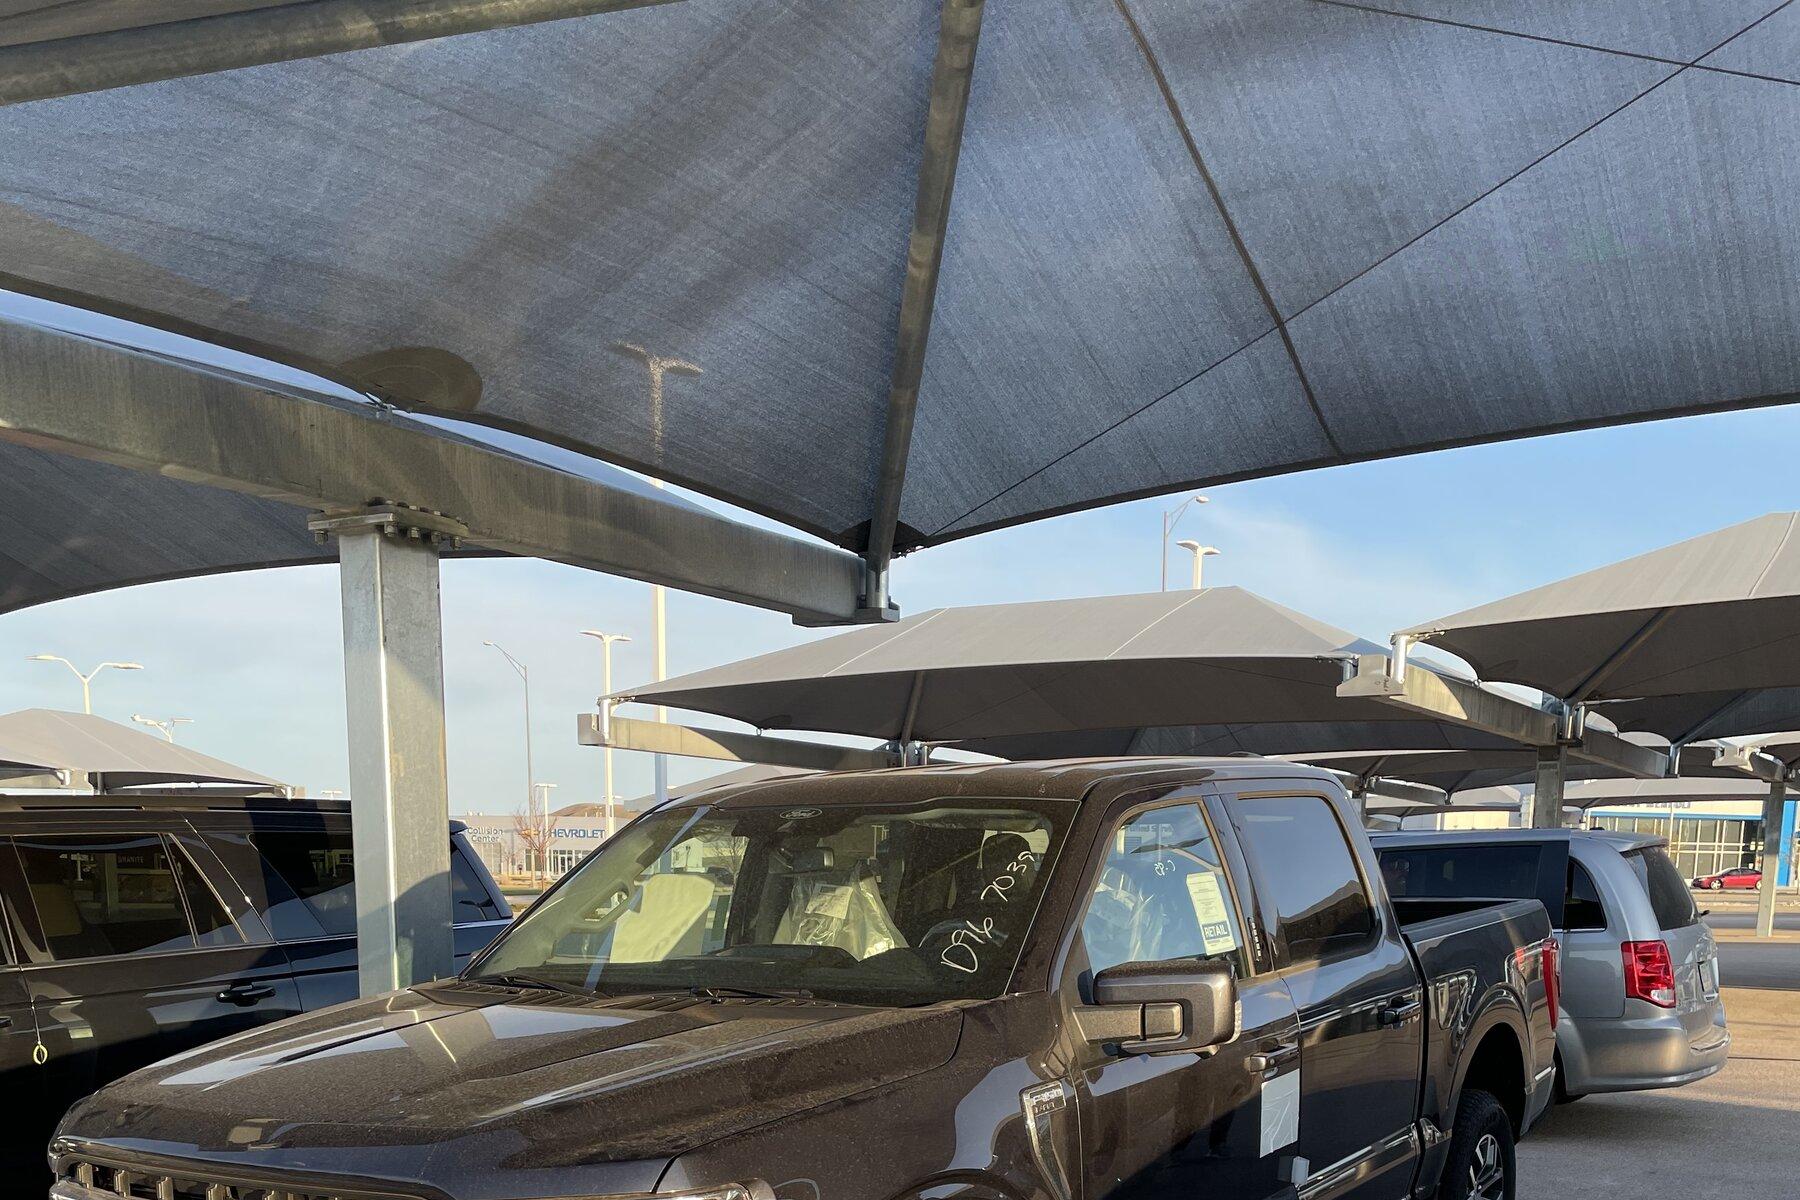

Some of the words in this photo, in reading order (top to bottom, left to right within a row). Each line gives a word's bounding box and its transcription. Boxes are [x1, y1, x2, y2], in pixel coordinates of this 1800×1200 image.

[467, 826, 504, 835] Collision
[471, 834, 500, 843] Center
[1203, 924, 1229, 938] RETAIL
